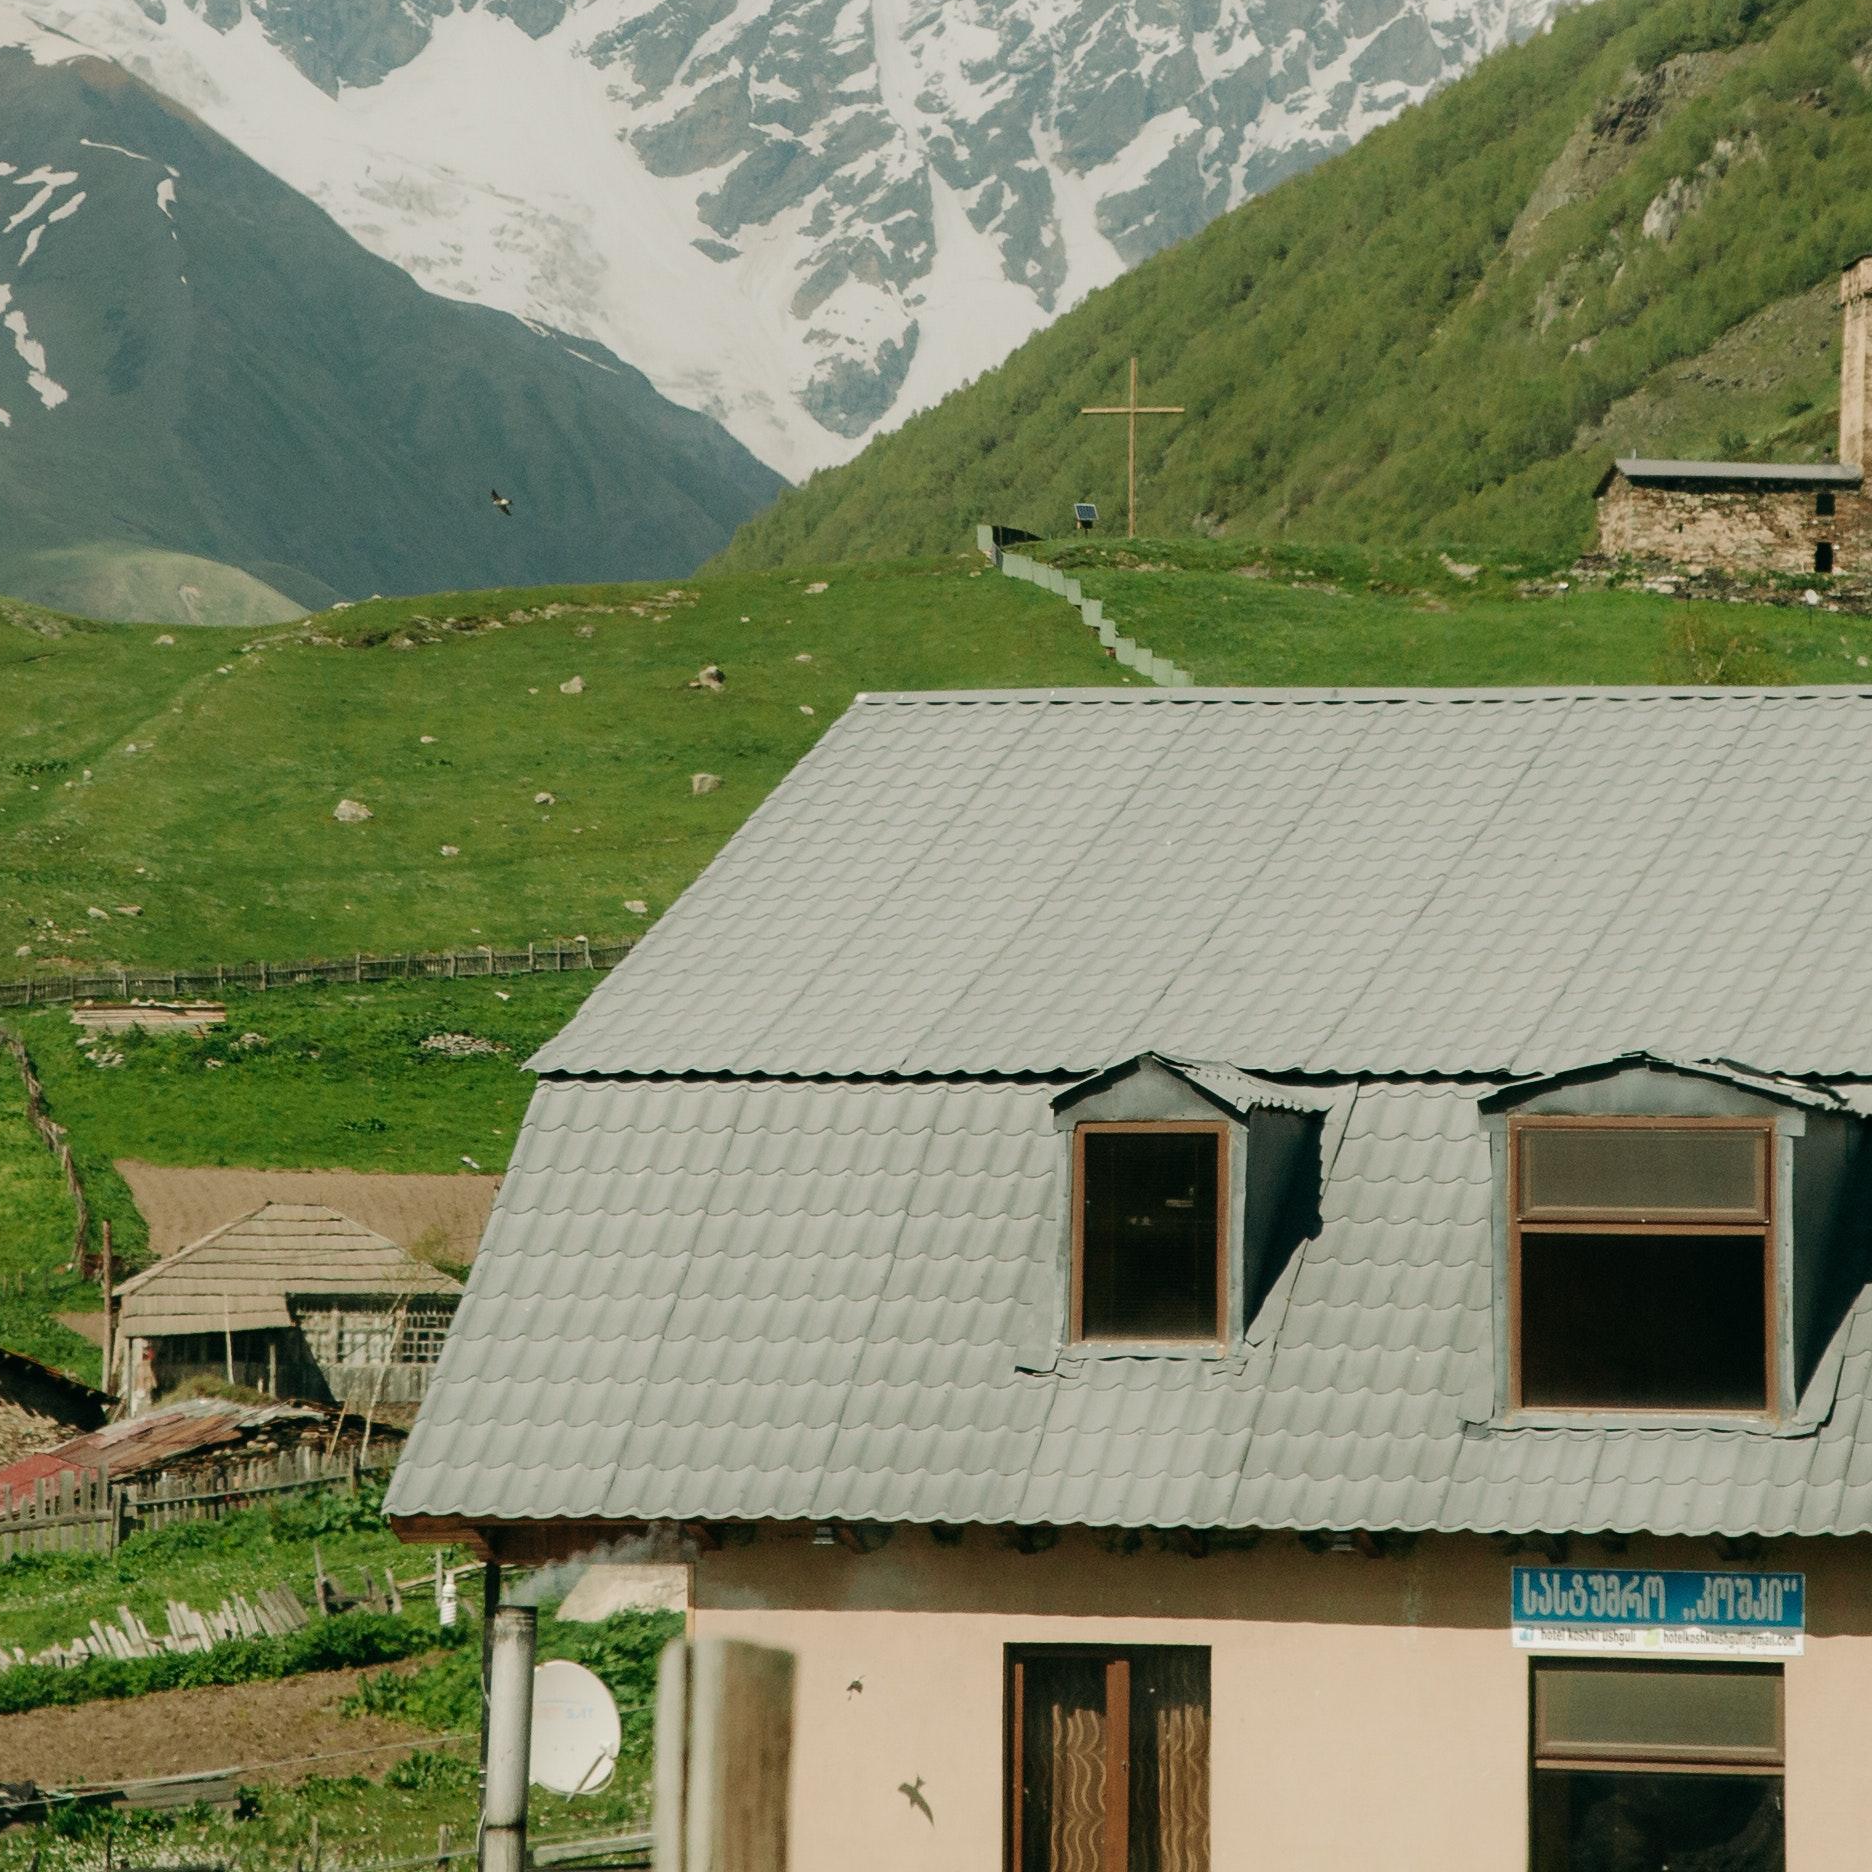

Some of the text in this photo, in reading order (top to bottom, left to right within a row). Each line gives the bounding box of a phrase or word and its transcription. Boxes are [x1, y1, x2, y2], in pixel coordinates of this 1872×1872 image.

[1522, 1572, 1666, 1620] სასტუმრო
[1540, 1627, 1637, 1646] hotel koshki ushguli
